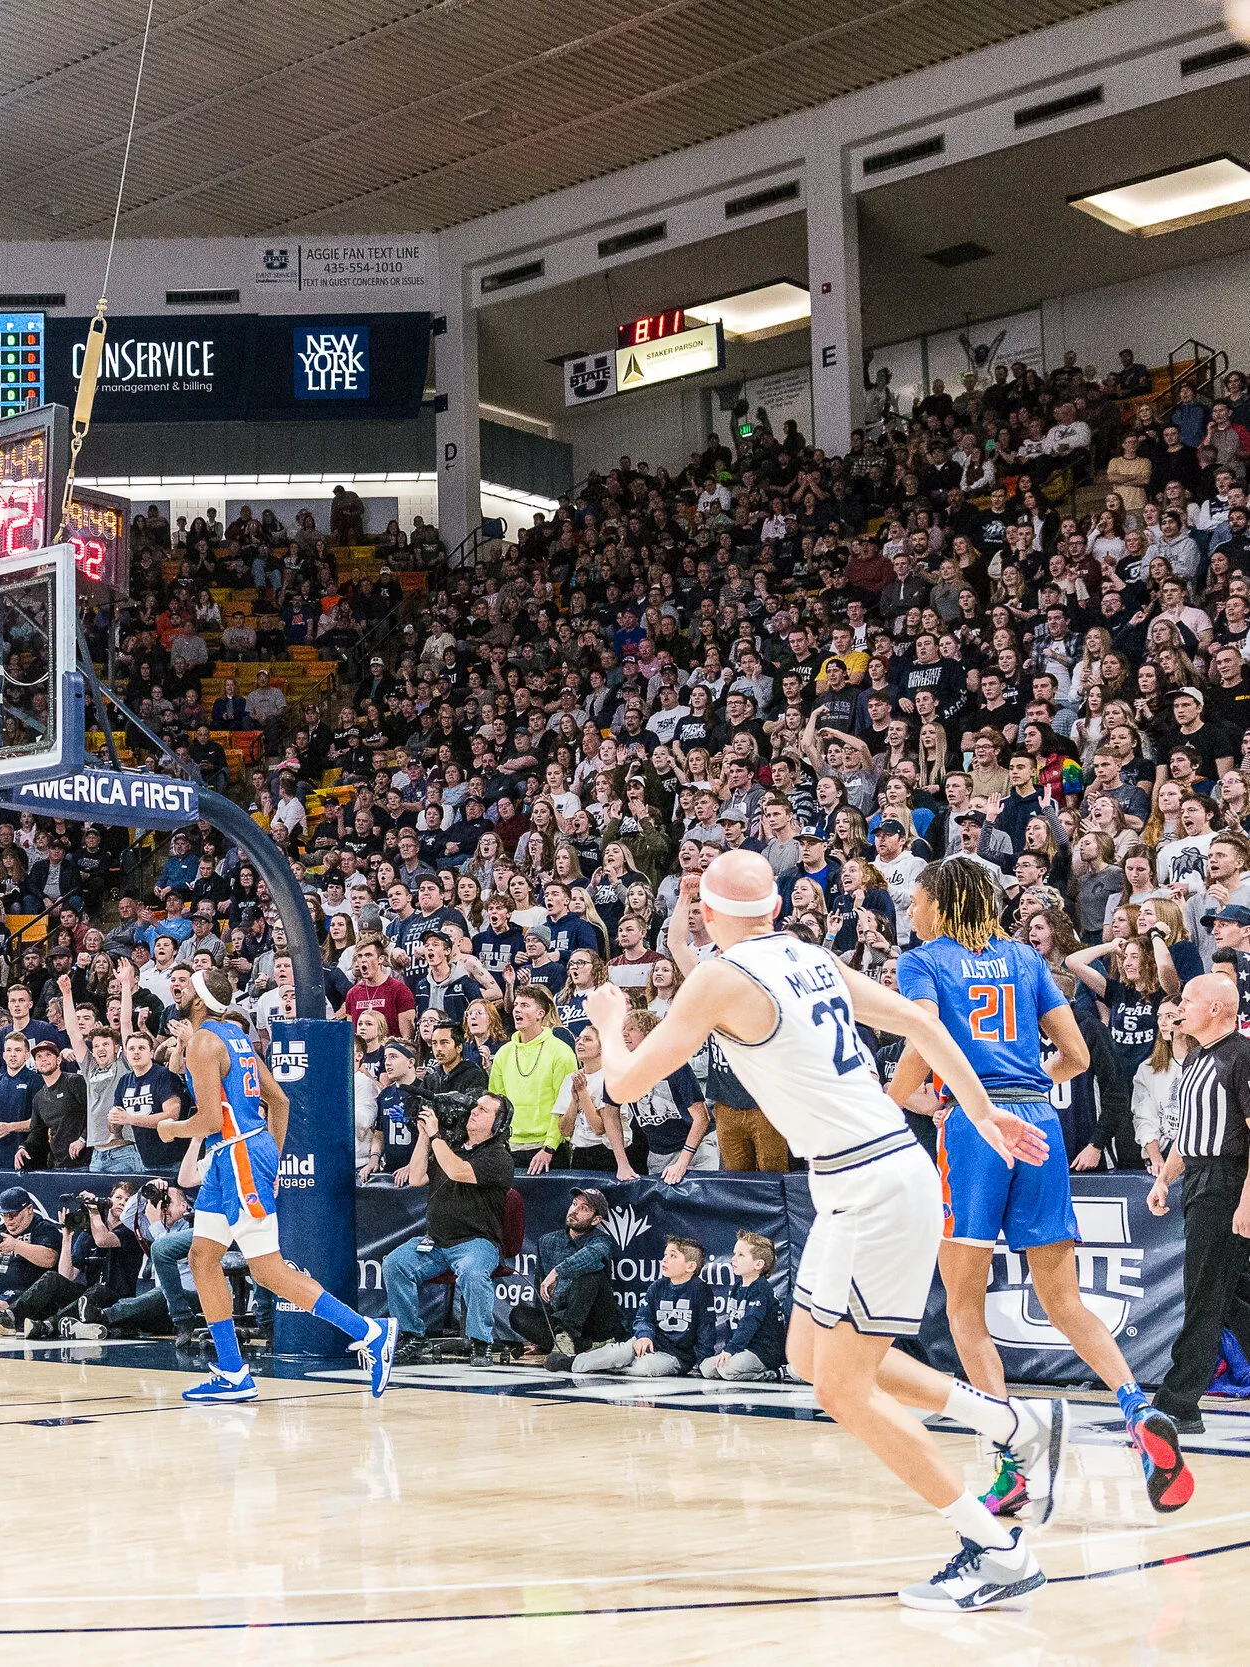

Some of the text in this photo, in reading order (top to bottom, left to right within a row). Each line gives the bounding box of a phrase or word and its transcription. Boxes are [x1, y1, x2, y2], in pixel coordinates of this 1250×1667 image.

[263, 255, 290, 264] STATE
[307, 246, 420, 260] AGGIE FAN TEXT LINE
[324, 261, 403, 273] 435-554-1010
[303, 278, 319, 287] TEXT
[320, 278, 328, 287] IN
[329, 278, 351, 287] GUEST
[352, 277, 389, 287] CONCERNS
[390, 277, 400, 287] OR
[401, 277, 425, 286] ISSUES
[306, 333, 359, 355] NEW
[646, 347, 673, 360] STAKER
[674, 340, 704, 354] PARSON
[72, 339, 215, 381] CNSERVICE
[298, 351, 365, 373] YORK
[821, 345, 837, 368] E
[307, 369, 358, 391] LIFE
[570, 367, 611, 388] STATE
[102, 382, 170, 394] management
[172, 381, 180, 391] &
[183, 381, 213, 393] billing
[444, 442, 458, 461] D
[925, 667, 943, 678] STATE
[907, 676, 940, 689] UNIVERSITY
[19, 774, 194, 812] AMERICA FIRST
[961, 957, 1010, 979] ALSTON
[968, 983, 1018, 1042] 21
[1117, 1002, 1152, 1017] UTAH
[1123, 1016, 1138, 1031] 5
[1111, 1028, 1154, 1045] STATE
[271, 1053, 309, 1068] STATE
[122, 1093, 154, 1108] STATE
[639, 1111, 680, 1126] AGGIES
[388, 1122, 412, 1146] 13
[278, 1154, 315, 1175] uild
[278, 1177, 316, 1189] rtgage
[656, 1308, 693, 1323] STATE
